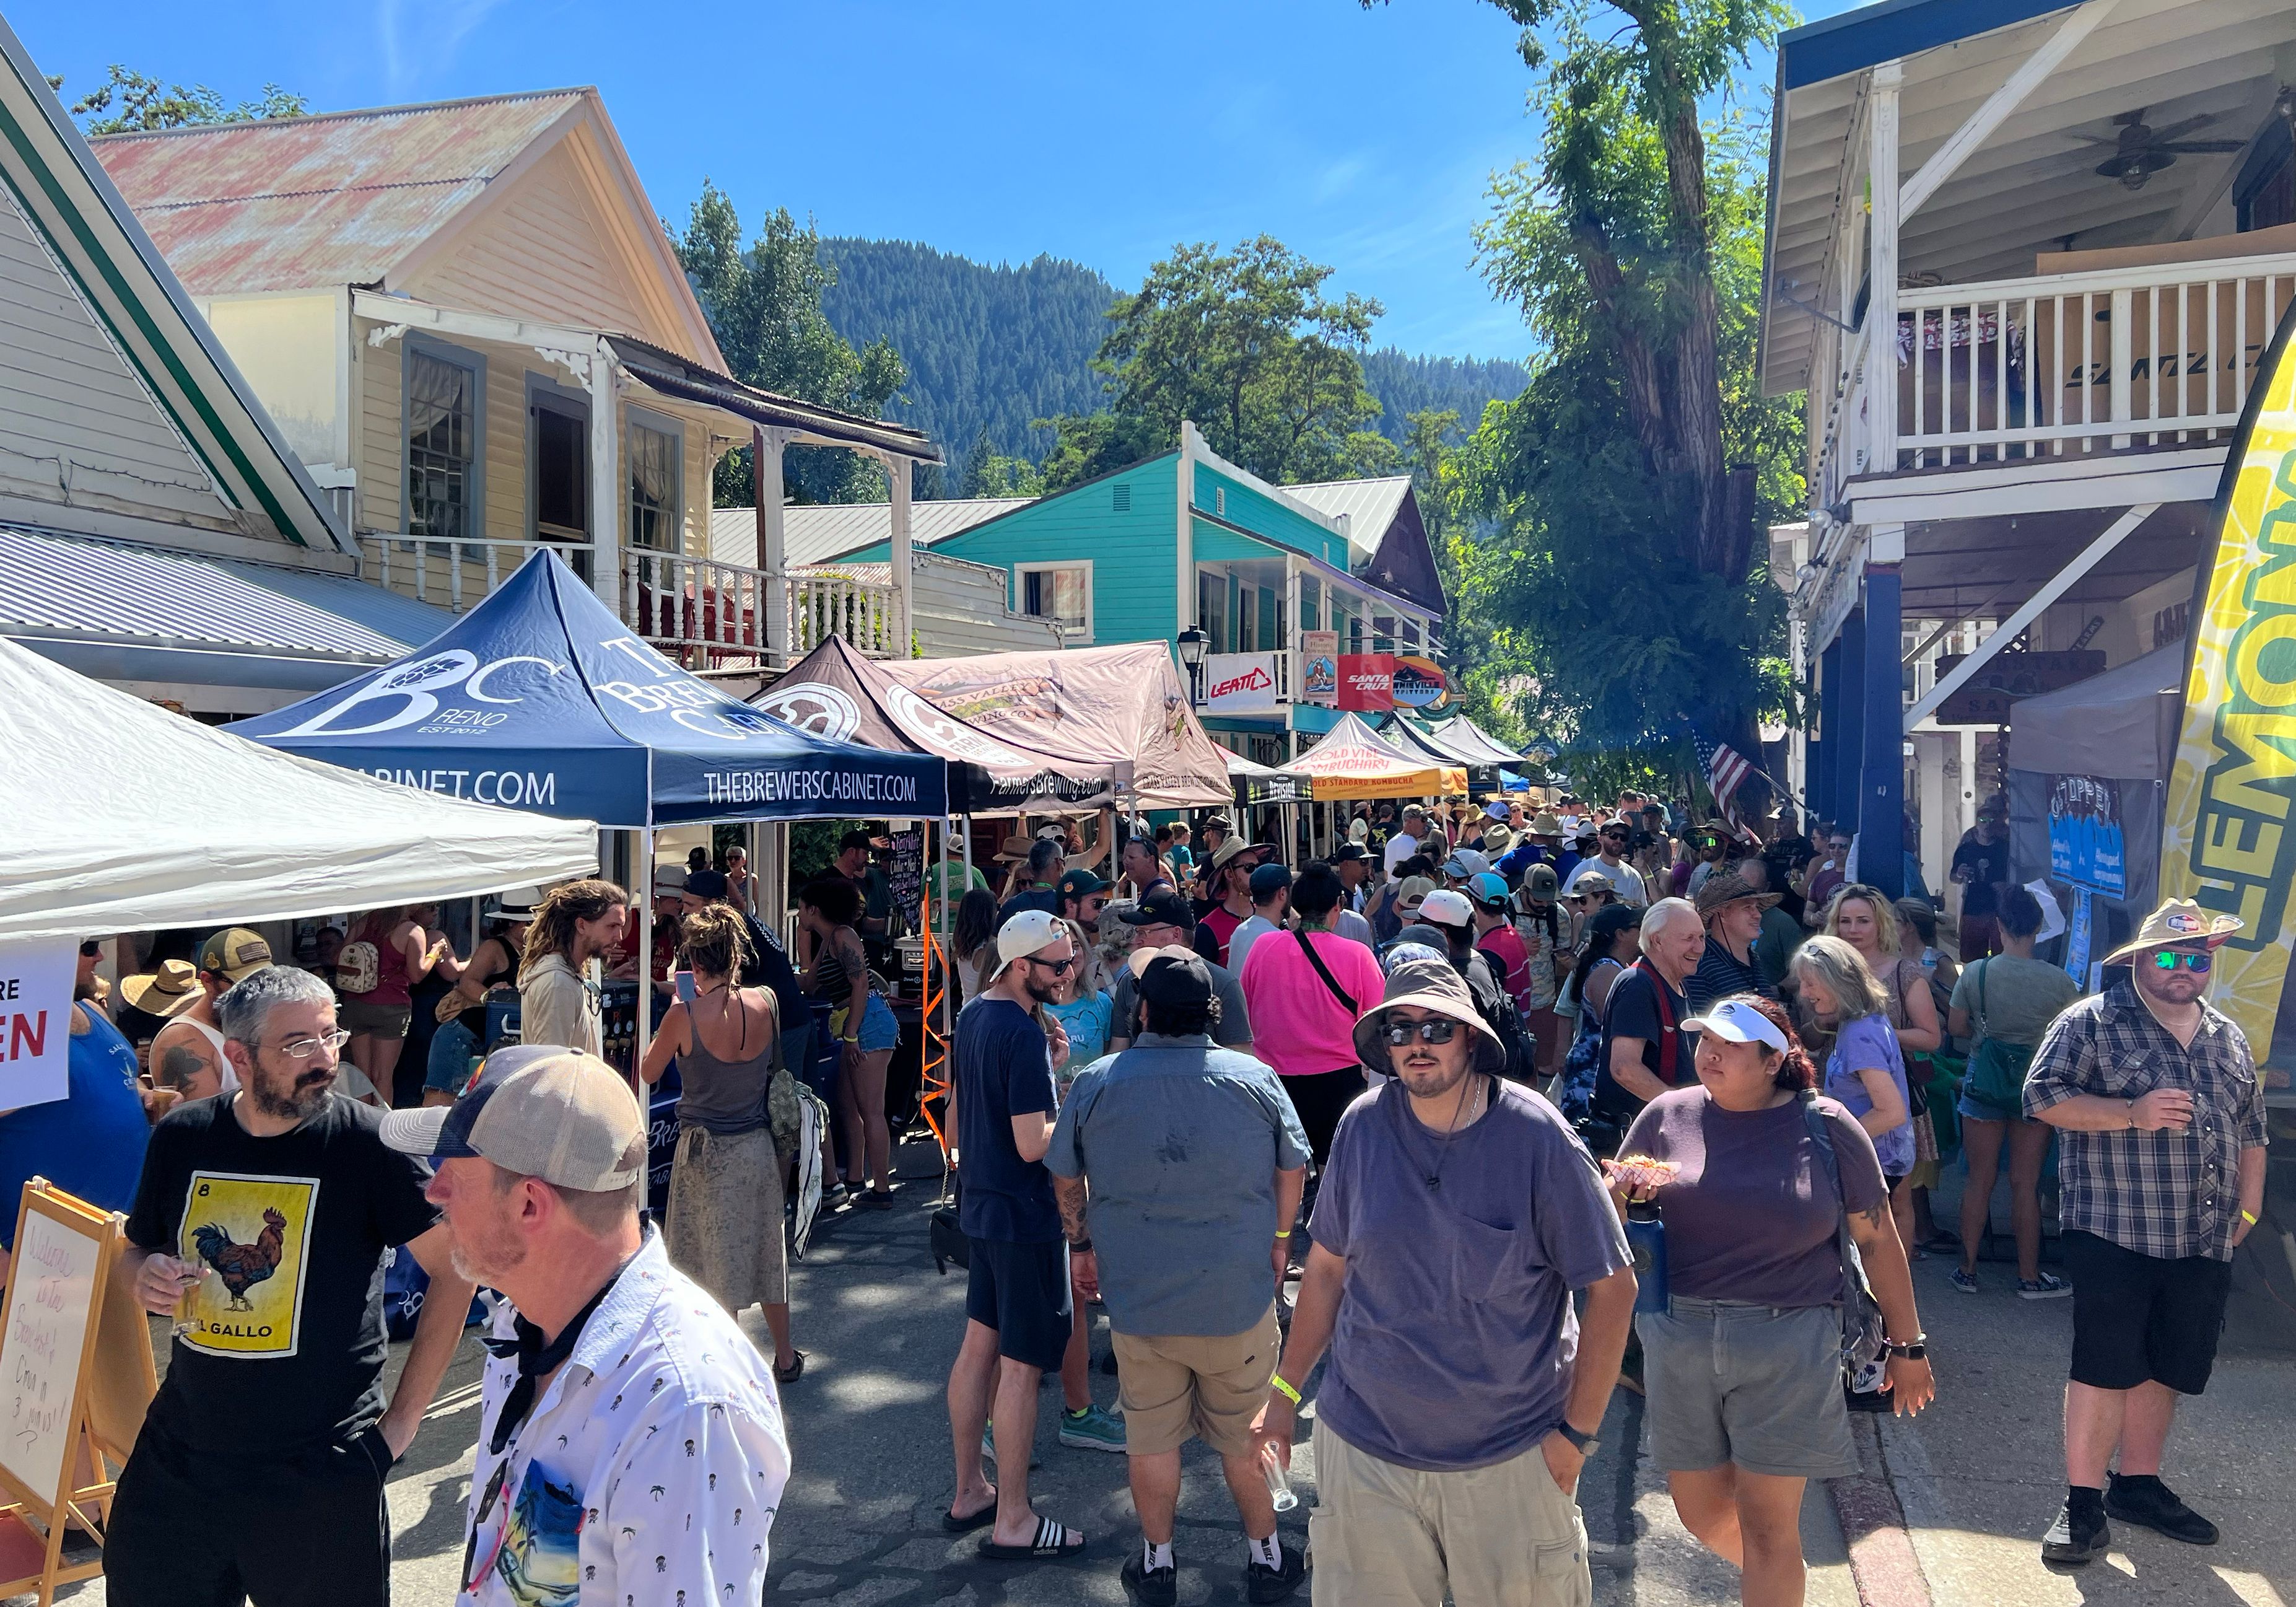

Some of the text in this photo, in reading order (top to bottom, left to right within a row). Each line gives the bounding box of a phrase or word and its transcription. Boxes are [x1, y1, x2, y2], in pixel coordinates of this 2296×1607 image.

[1347, 674, 1390, 683] SANTA
[1355, 683, 1390, 691] CRUZ
[933, 698, 965, 709] ASS
[2201, 455, 2296, 941] LEMON
[432, 708, 508, 727] RENO
[965, 711, 1006, 725] WING
[416, 726, 488, 735] EST 2012
[1310, 747, 1379, 762] GOLD VIBE
[1294, 757, 1390, 773] KOMBUCHARY
[357, 768, 556, 806] INET.COM
[703, 770, 917, 804] THEBREWERSCABINET.COM
[987, 769, 1102, 800] FarmersBrewing.com
[1330, 777, 1368, 787] STANDARD
[1371, 776, 1414, 786] KOMBUCHA
[0, 1010, 48, 1063] N
[198, 1184, 210, 1196] 8
[197, 1318, 273, 1338] L GALLO
[1033, 1547, 1059, 1556] adidas
